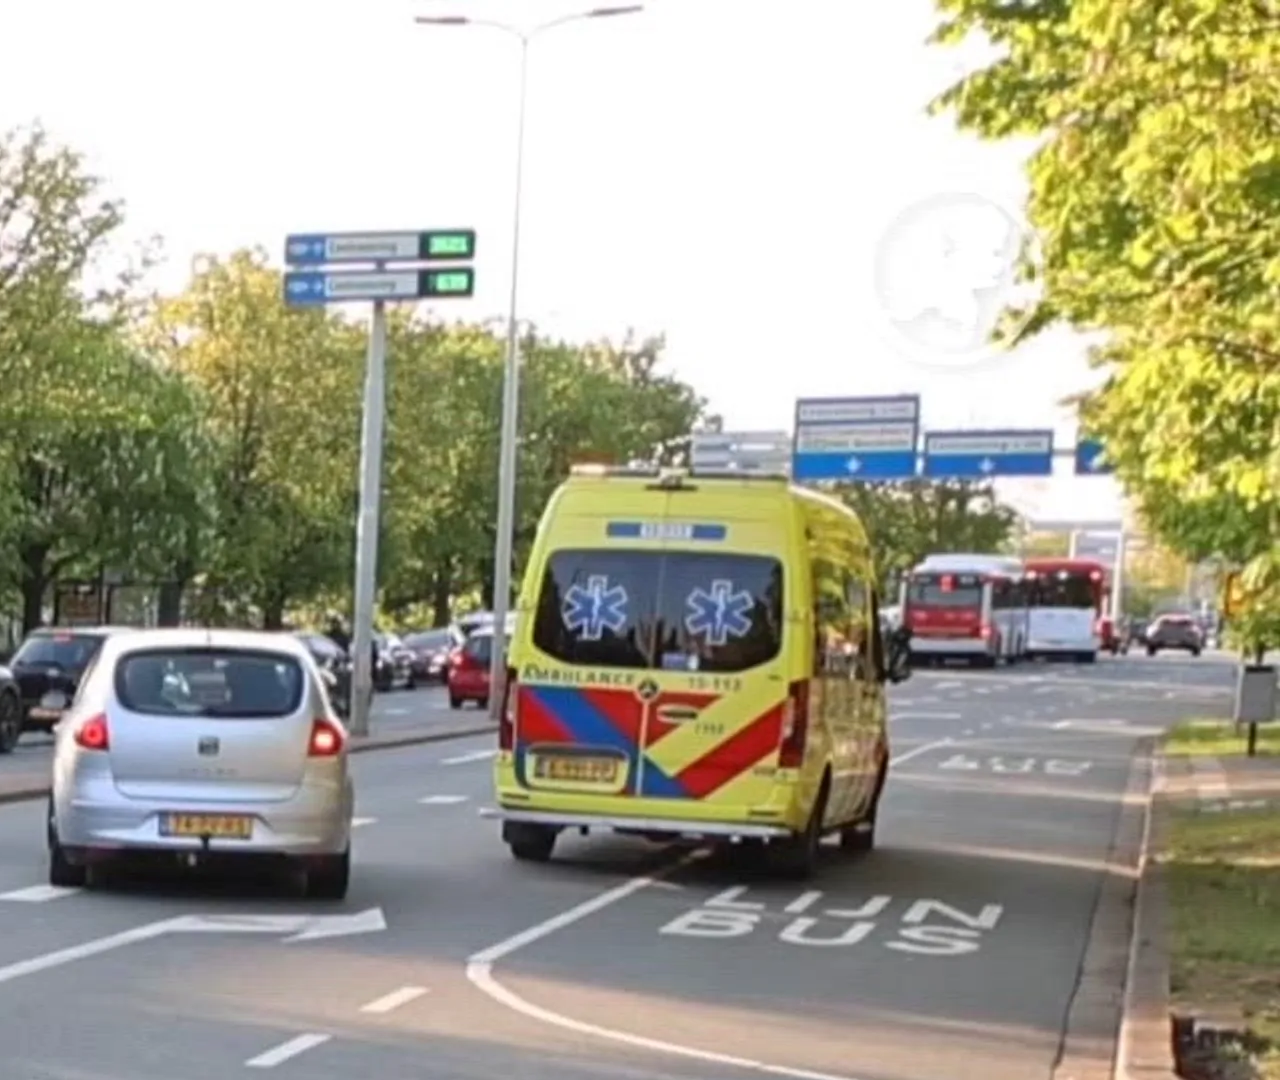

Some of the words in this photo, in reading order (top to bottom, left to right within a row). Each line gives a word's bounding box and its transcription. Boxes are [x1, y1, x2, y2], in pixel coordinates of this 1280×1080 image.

[522, 664, 635, 685] AMBULANCE
[705, 886, 1002, 928] LIJN
[659, 909, 982, 954] BUS
